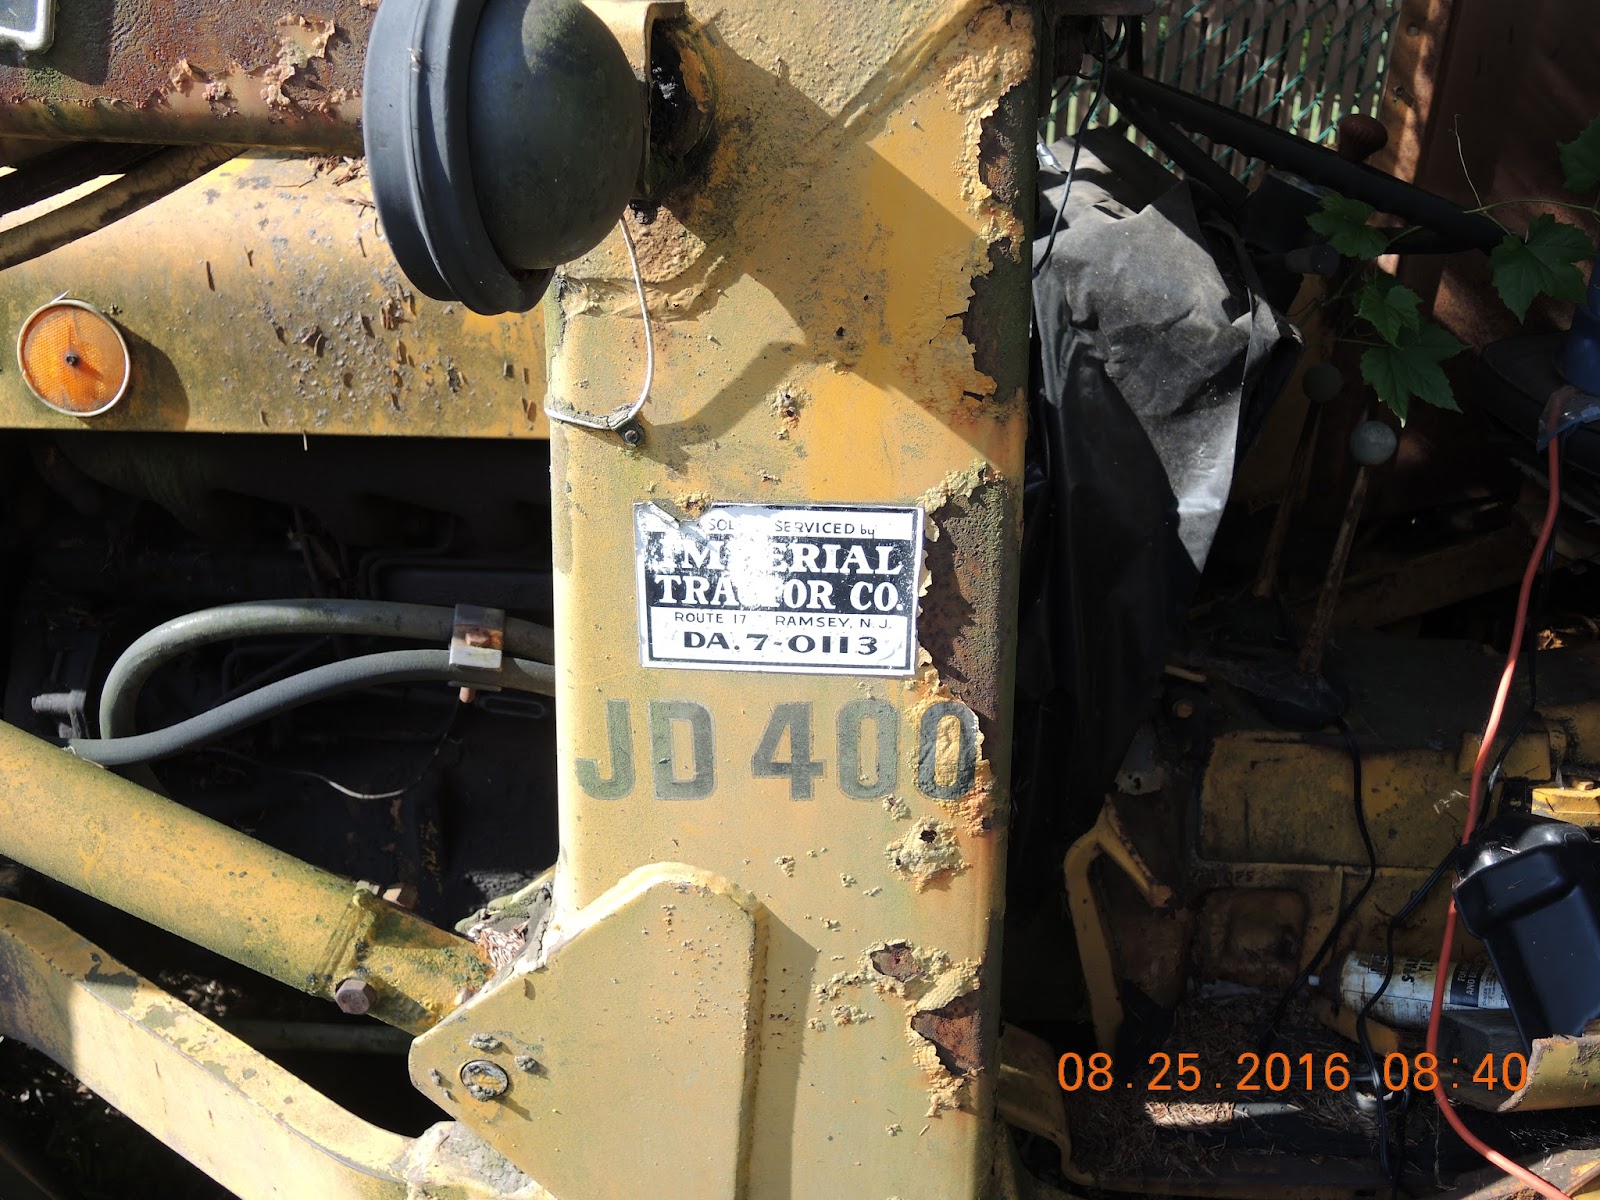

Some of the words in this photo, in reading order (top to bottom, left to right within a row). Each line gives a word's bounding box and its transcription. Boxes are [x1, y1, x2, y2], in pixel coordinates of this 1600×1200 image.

[775, 519, 855, 535] SERVICED
[860, 527, 875, 538] by
[655, 539, 903, 575] IMERIAL
[850, 581, 903, 611] CO.
[675, 611, 723, 623] ROUTE
[734, 614, 746, 624] 17
[684, 631, 740, 651] DA.
[574, 699, 717, 801] JD
[750, 699, 981, 801] 400
[1465, 977, 1476, 996] AND
